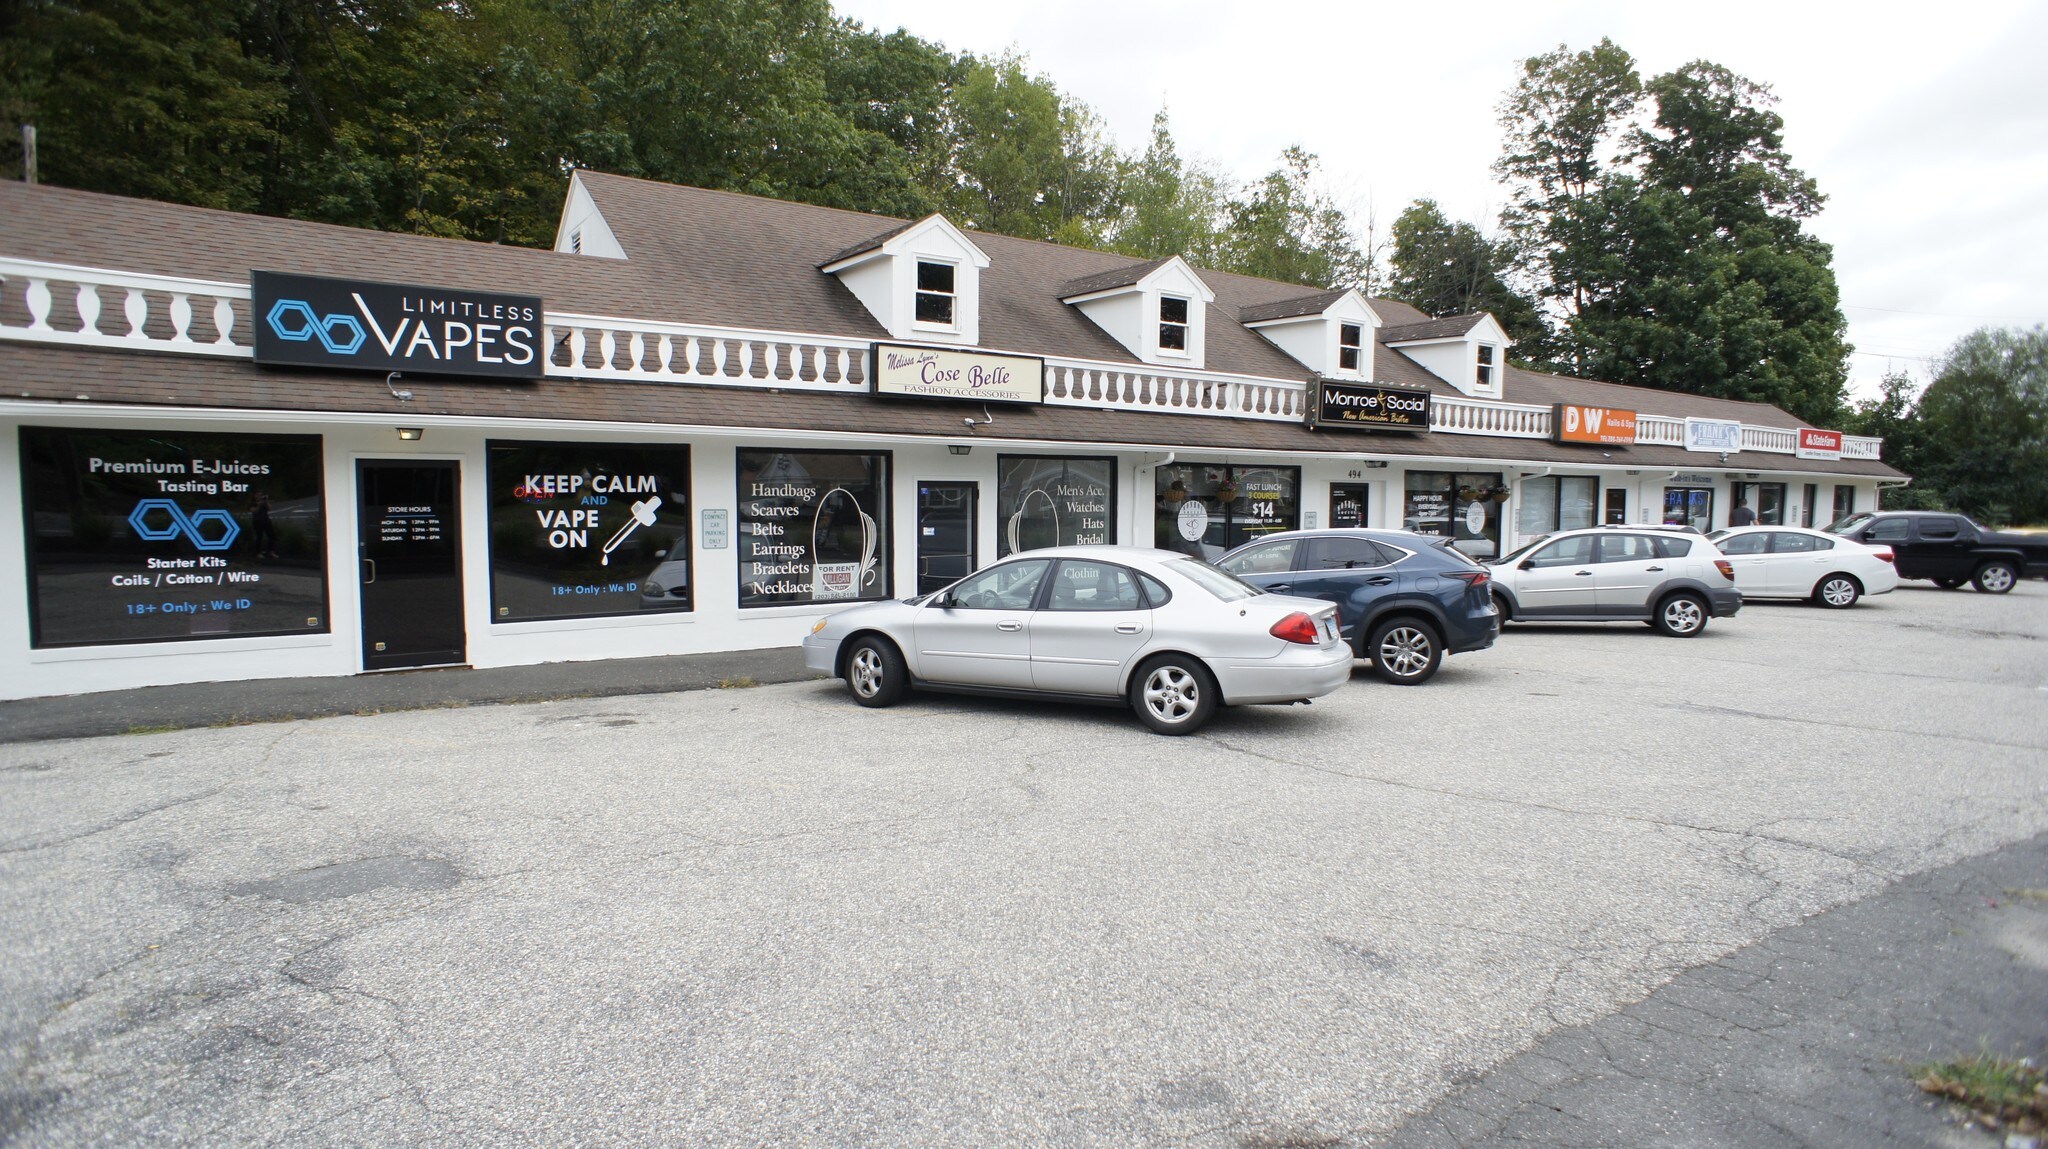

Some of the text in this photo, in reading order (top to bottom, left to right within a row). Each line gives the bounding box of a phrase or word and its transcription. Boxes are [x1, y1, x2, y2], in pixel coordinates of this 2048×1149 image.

[403, 297, 534, 322] LIMITLESS
[351, 292, 534, 365] VAPES
[887, 352, 939, 370] Melissa Lynn's
[921, 361, 1010, 388] Cose Belle
[904, 385, 1020, 400] FASHION ACCESSORIES
[1325, 390, 1425, 411] Monroe Social
[1342, 410, 1409, 424] New American Bistro
[1607, 418, 1635, 429] Nails & Spa
[89, 457, 270, 475] Premium E-Juices
[1348, 470, 1361, 479] 494
[157, 480, 249, 495] Tasting Bar
[524, 475, 657, 493] KEEP CALM
[1057, 484, 1105, 496] Men's Acc.
[1246, 483, 1282, 491] FAST LUNCH
[752, 483, 817, 502] Handbags
[1253, 491, 1280, 499] COURSES
[581, 496, 608, 505] AND
[1066, 501, 1105, 513] Watches
[751, 502, 800, 517] Scarves
[1252, 501, 1274, 518] $14
[536, 510, 599, 528] VAPE
[1083, 518, 1104, 529] Hats
[752, 522, 784, 536] Belts
[549, 530, 588, 548] ON
[1076, 533, 1104, 545] Bridal
[752, 542, 806, 560] Earrings
[147, 556, 227, 569] Starter Kits
[752, 561, 810, 576] Bracelets
[111, 571, 260, 588] Coils / Cotton / Wire
[1064, 567, 1100, 579] Clothin
[551, 586, 572, 595] 18+
[575, 585, 600, 596] Only
[609, 584, 624, 593] We
[626, 583, 637, 592] ID
[753, 580, 815, 595] Necklaces
[127, 604, 157, 615] 18+
[161, 601, 198, 614] Only
[210, 600, 233, 611] We
[236, 599, 250, 609] ID
